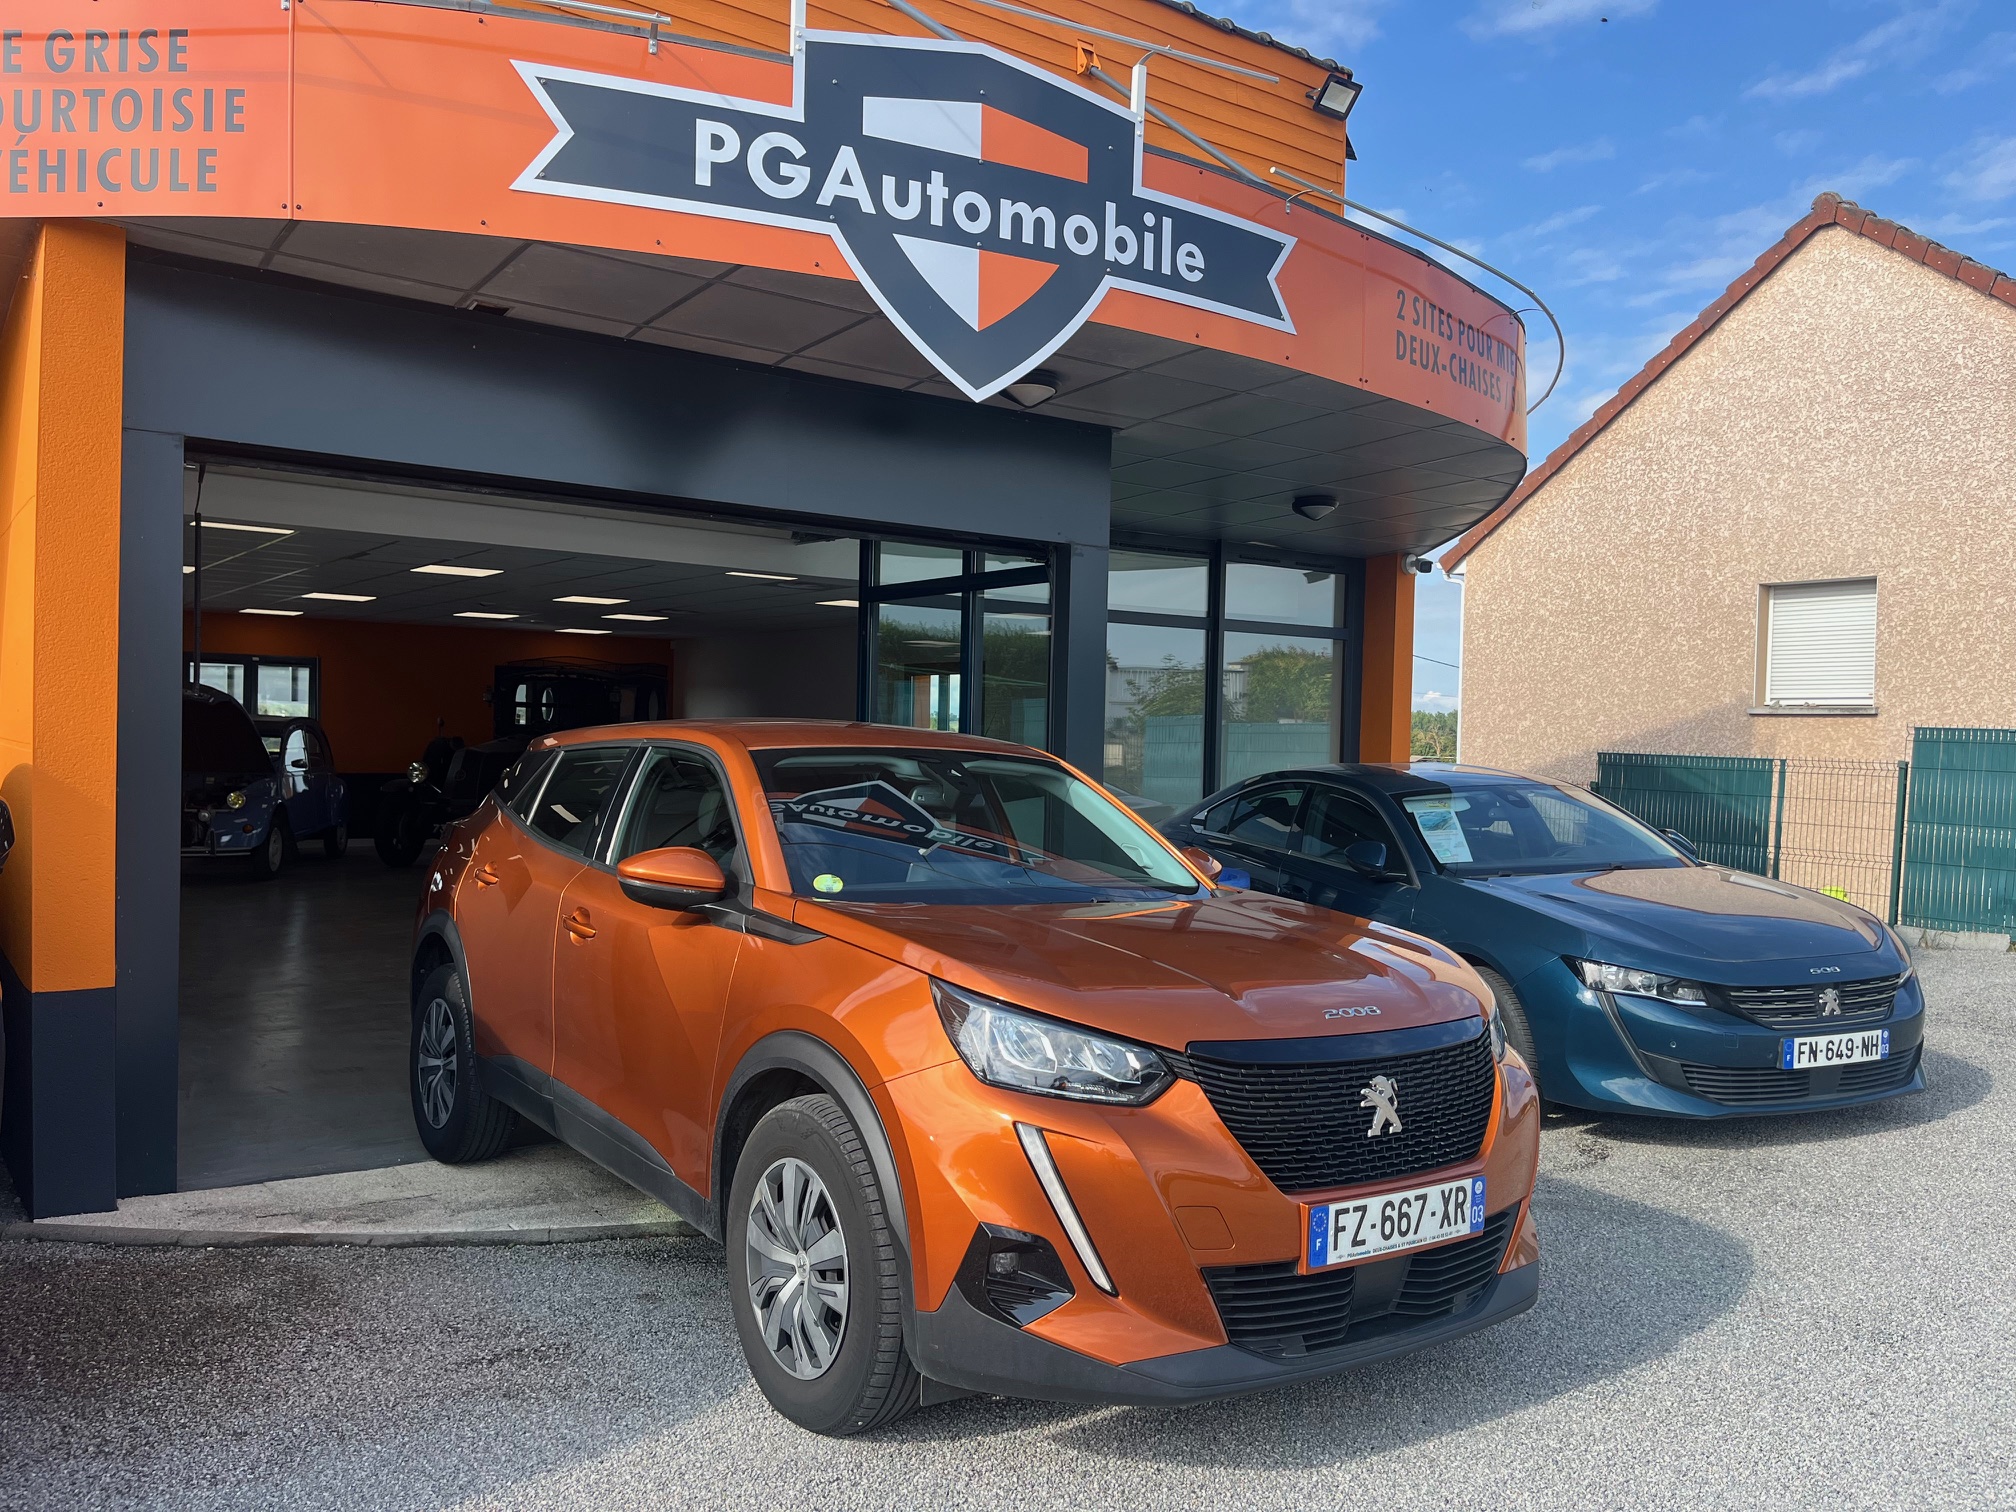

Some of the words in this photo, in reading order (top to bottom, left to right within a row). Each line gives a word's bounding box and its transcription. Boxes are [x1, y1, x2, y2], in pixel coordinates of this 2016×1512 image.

[44, 29, 189, 73] GRISE
[0, 89, 245, 133] URTOISIE
[0, 135, 218, 193] ÉHICULE
[695, 118, 1206, 284] PGAutomobile
[1396, 289, 1406, 321] 2
[1412, 296, 1453, 342] SITES
[1458, 317, 1493, 363] POUR
[1396, 329, 1502, 404] DEUX-CHAISES
[1322, 1005, 1382, 1020] 2008
[1797, 1034, 1879, 1064] FN-649-NH
[1316, 1238, 1321, 1251] F
[1333, 1186, 1467, 1251] FZ-667-XR
[1472, 1204, 1484, 1224] 03
